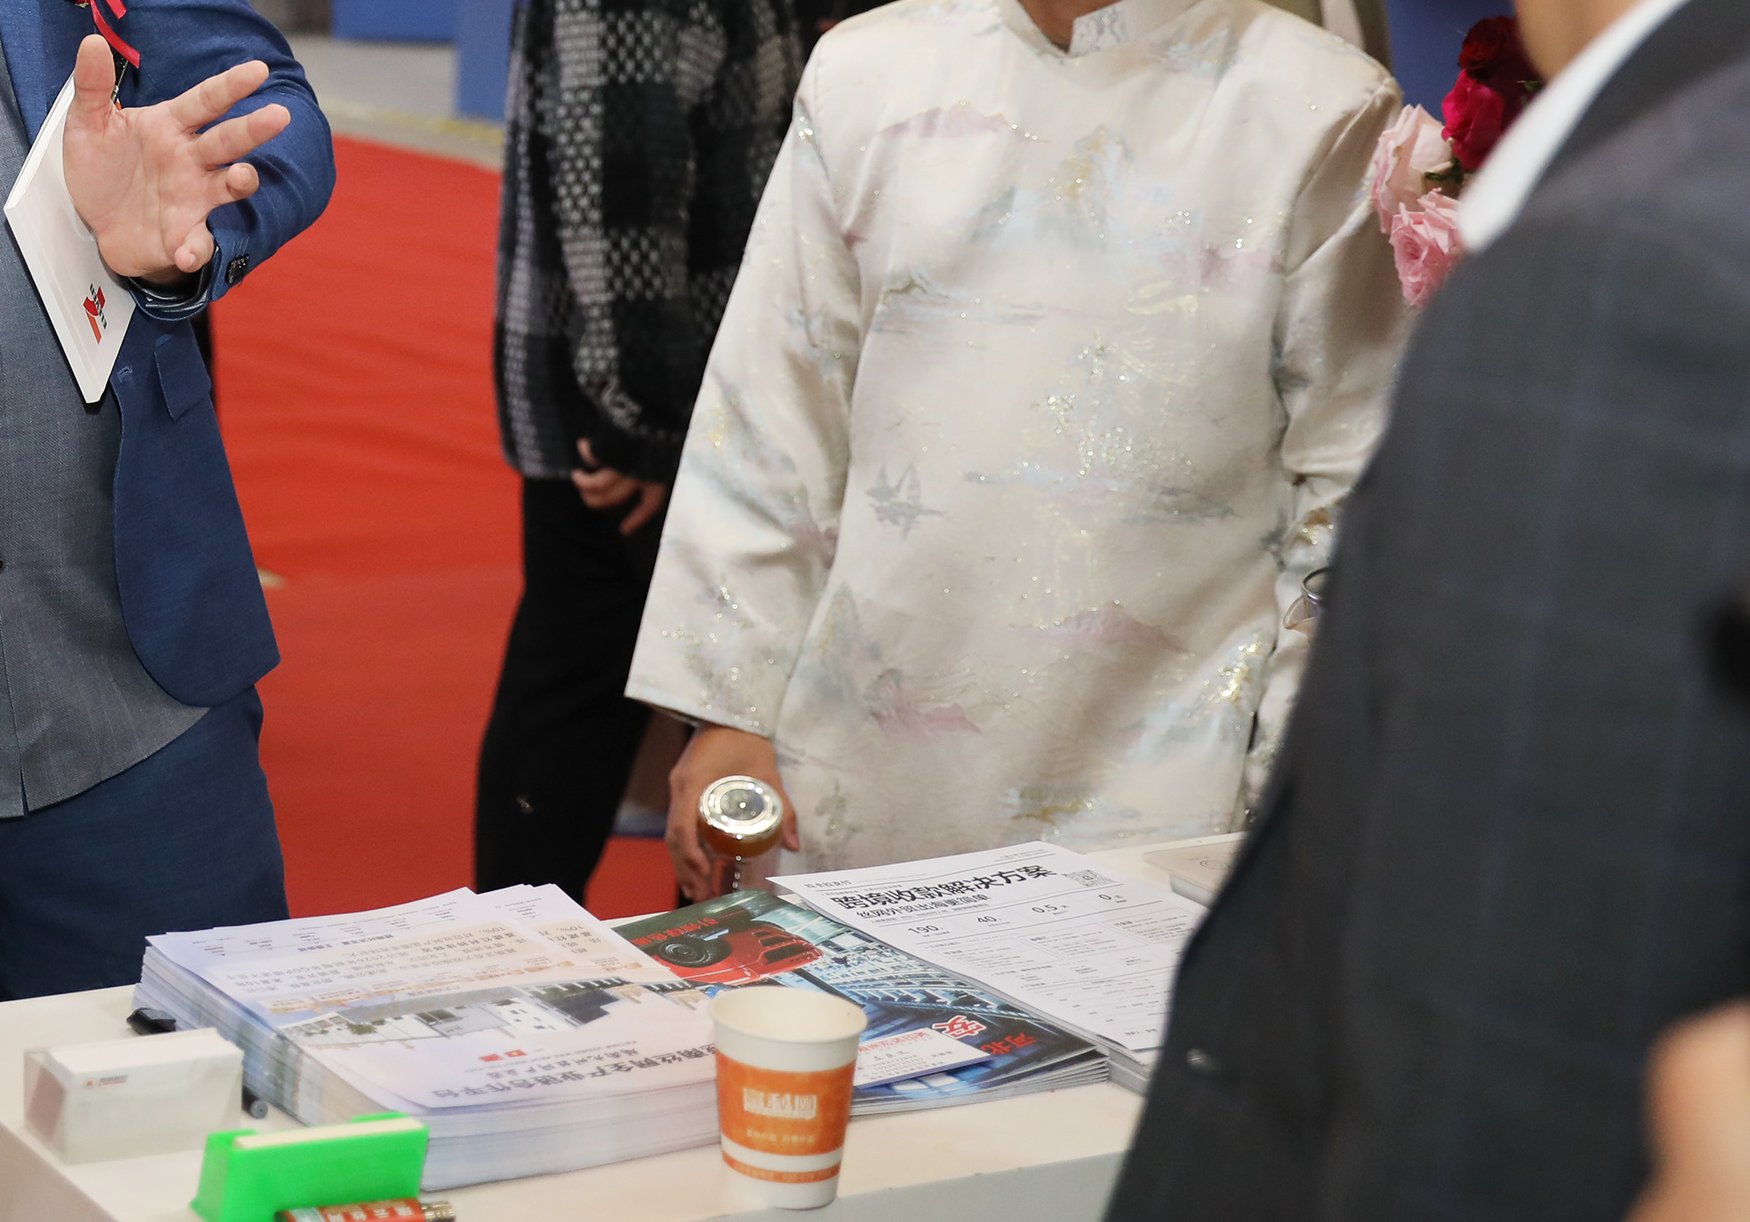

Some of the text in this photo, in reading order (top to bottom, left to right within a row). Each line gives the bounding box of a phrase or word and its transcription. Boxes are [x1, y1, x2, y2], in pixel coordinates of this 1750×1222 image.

[830, 865, 1058, 909] 跨境收款解决方案
[932, 1014, 987, 1040] 安
[980, 1032, 1037, 1055] 河北
